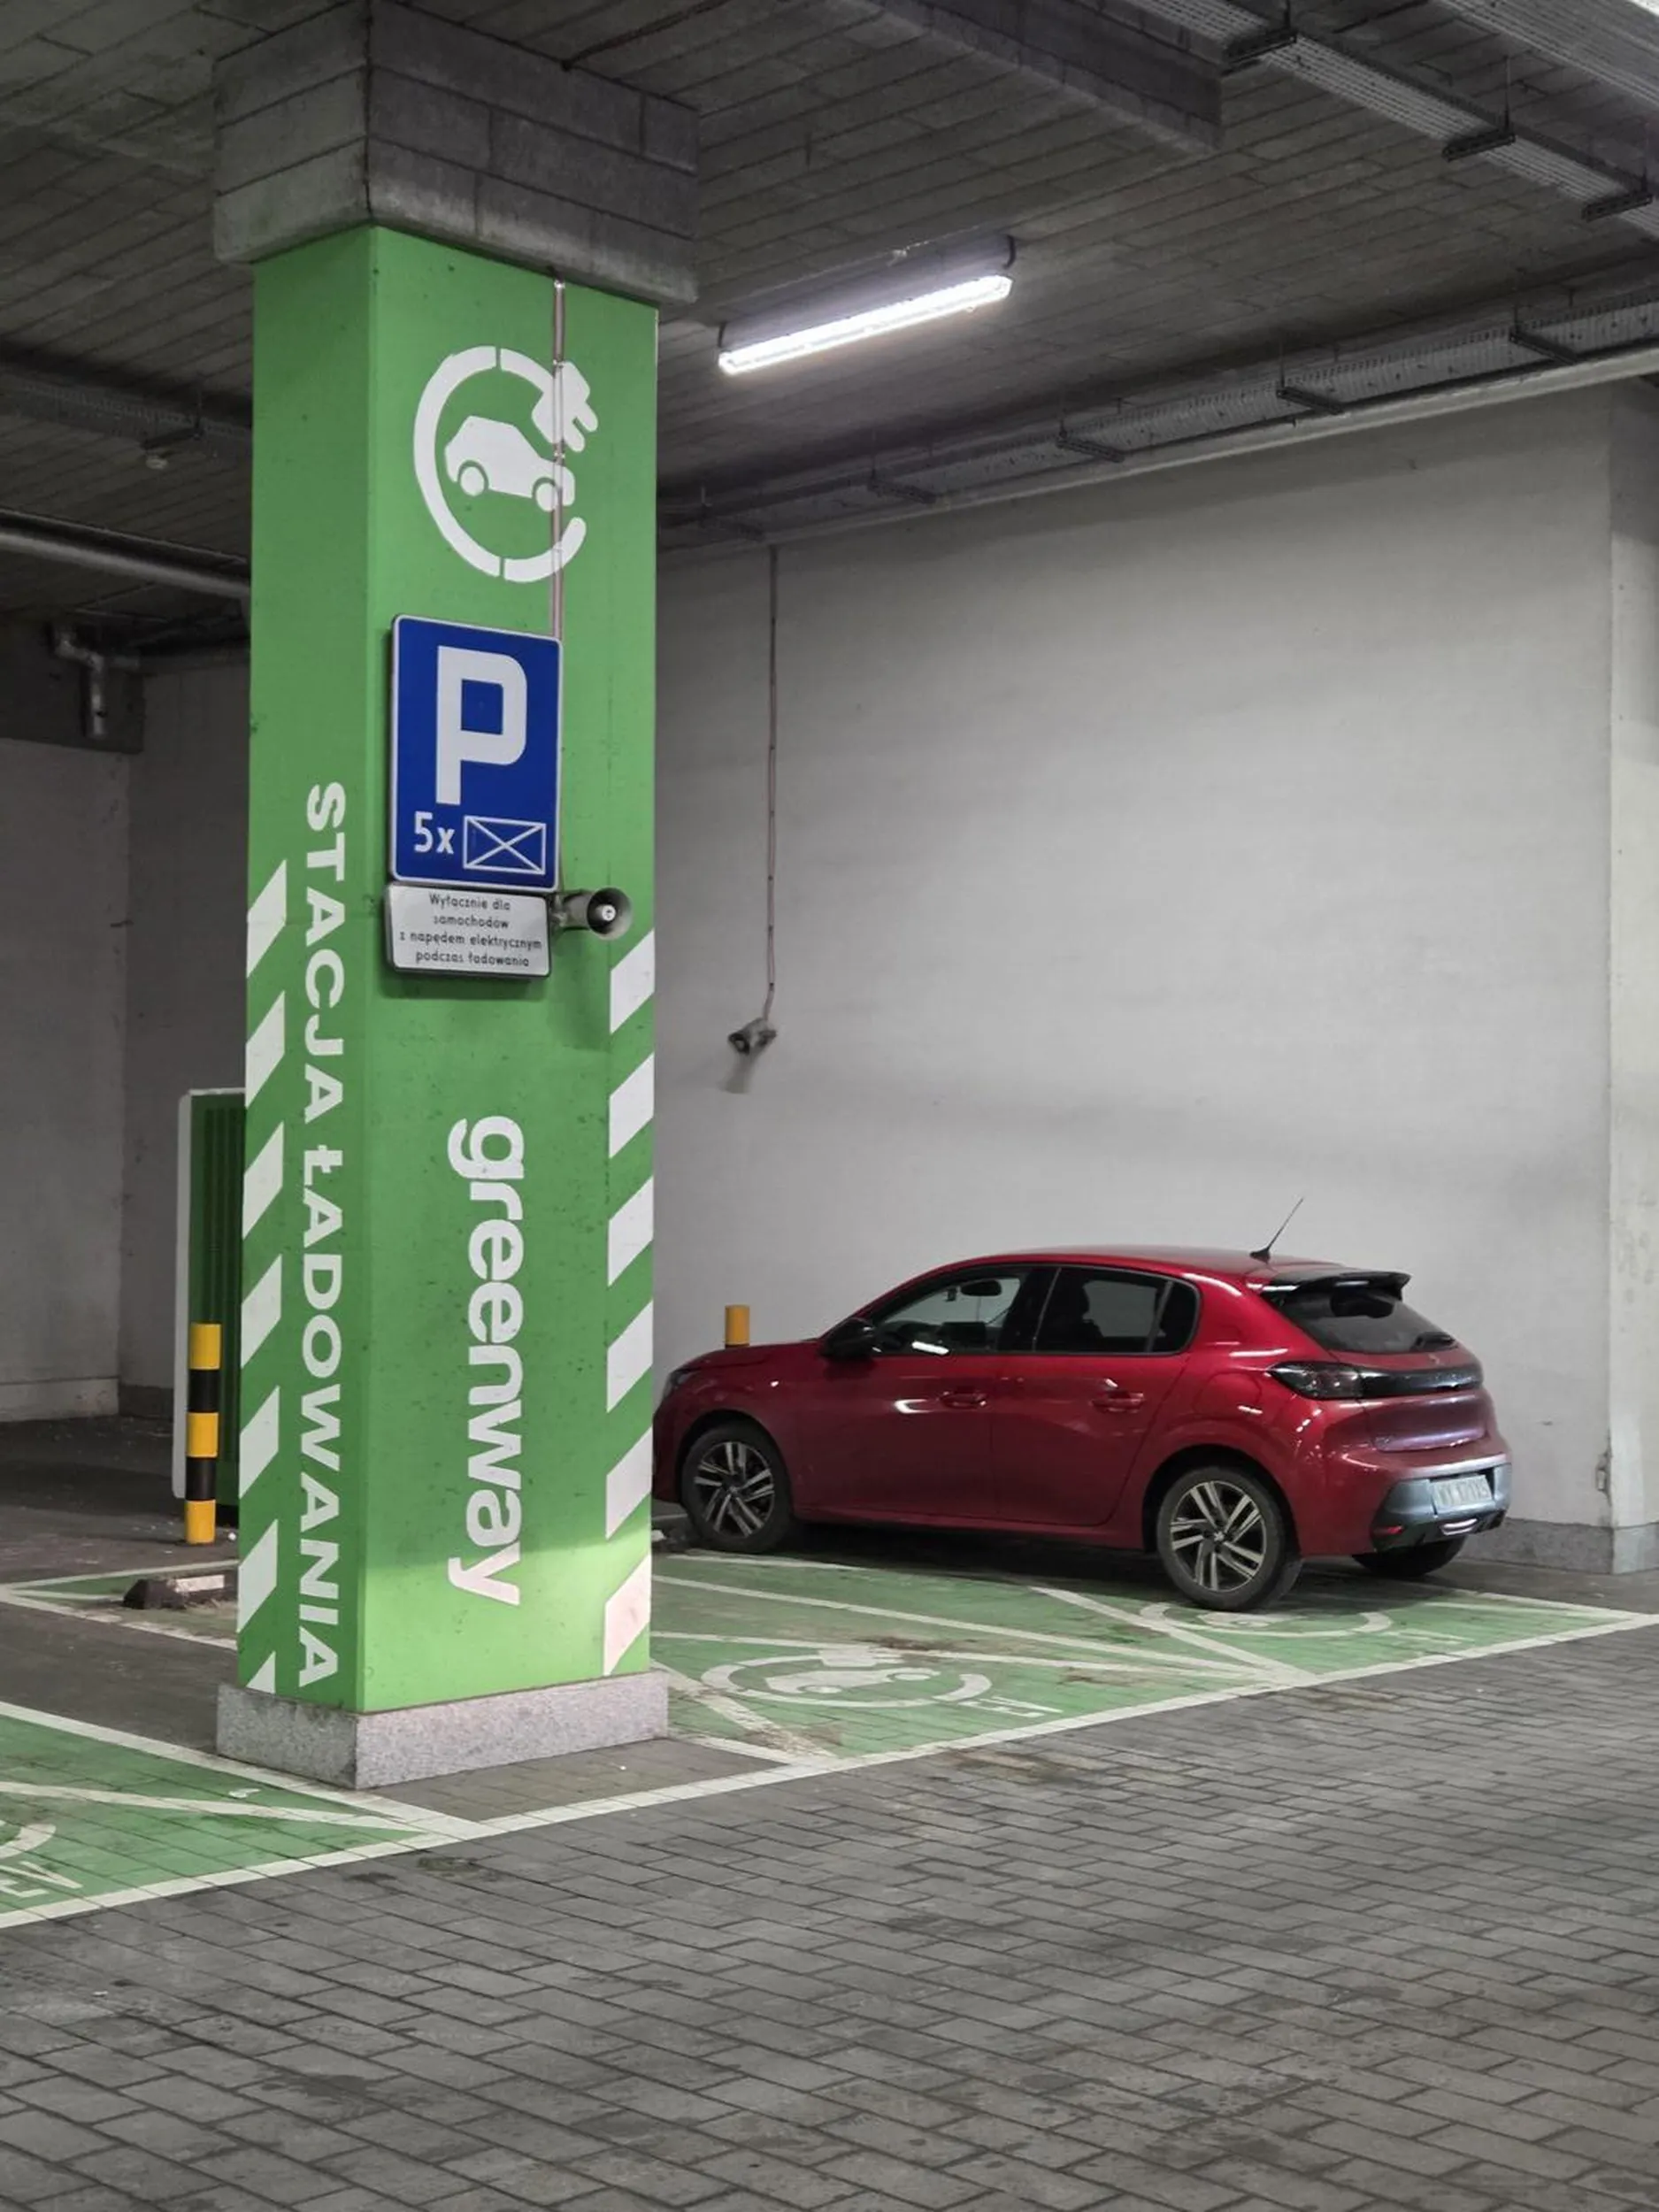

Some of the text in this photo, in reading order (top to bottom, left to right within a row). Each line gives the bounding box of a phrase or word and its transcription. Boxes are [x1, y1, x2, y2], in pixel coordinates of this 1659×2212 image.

[435, 645, 528, 806] P
[412, 810, 455, 856] 5x
[492, 899, 511, 911] dla
[399, 931, 543, 951] z napędem elektrycznym
[415, 951, 530, 967] podczas ładowania
[298, 781, 347, 1688] STACJA ŁADOWANIA
[447, 1116, 525, 1606] greenway
[957, 1696, 1062, 1717] EV
